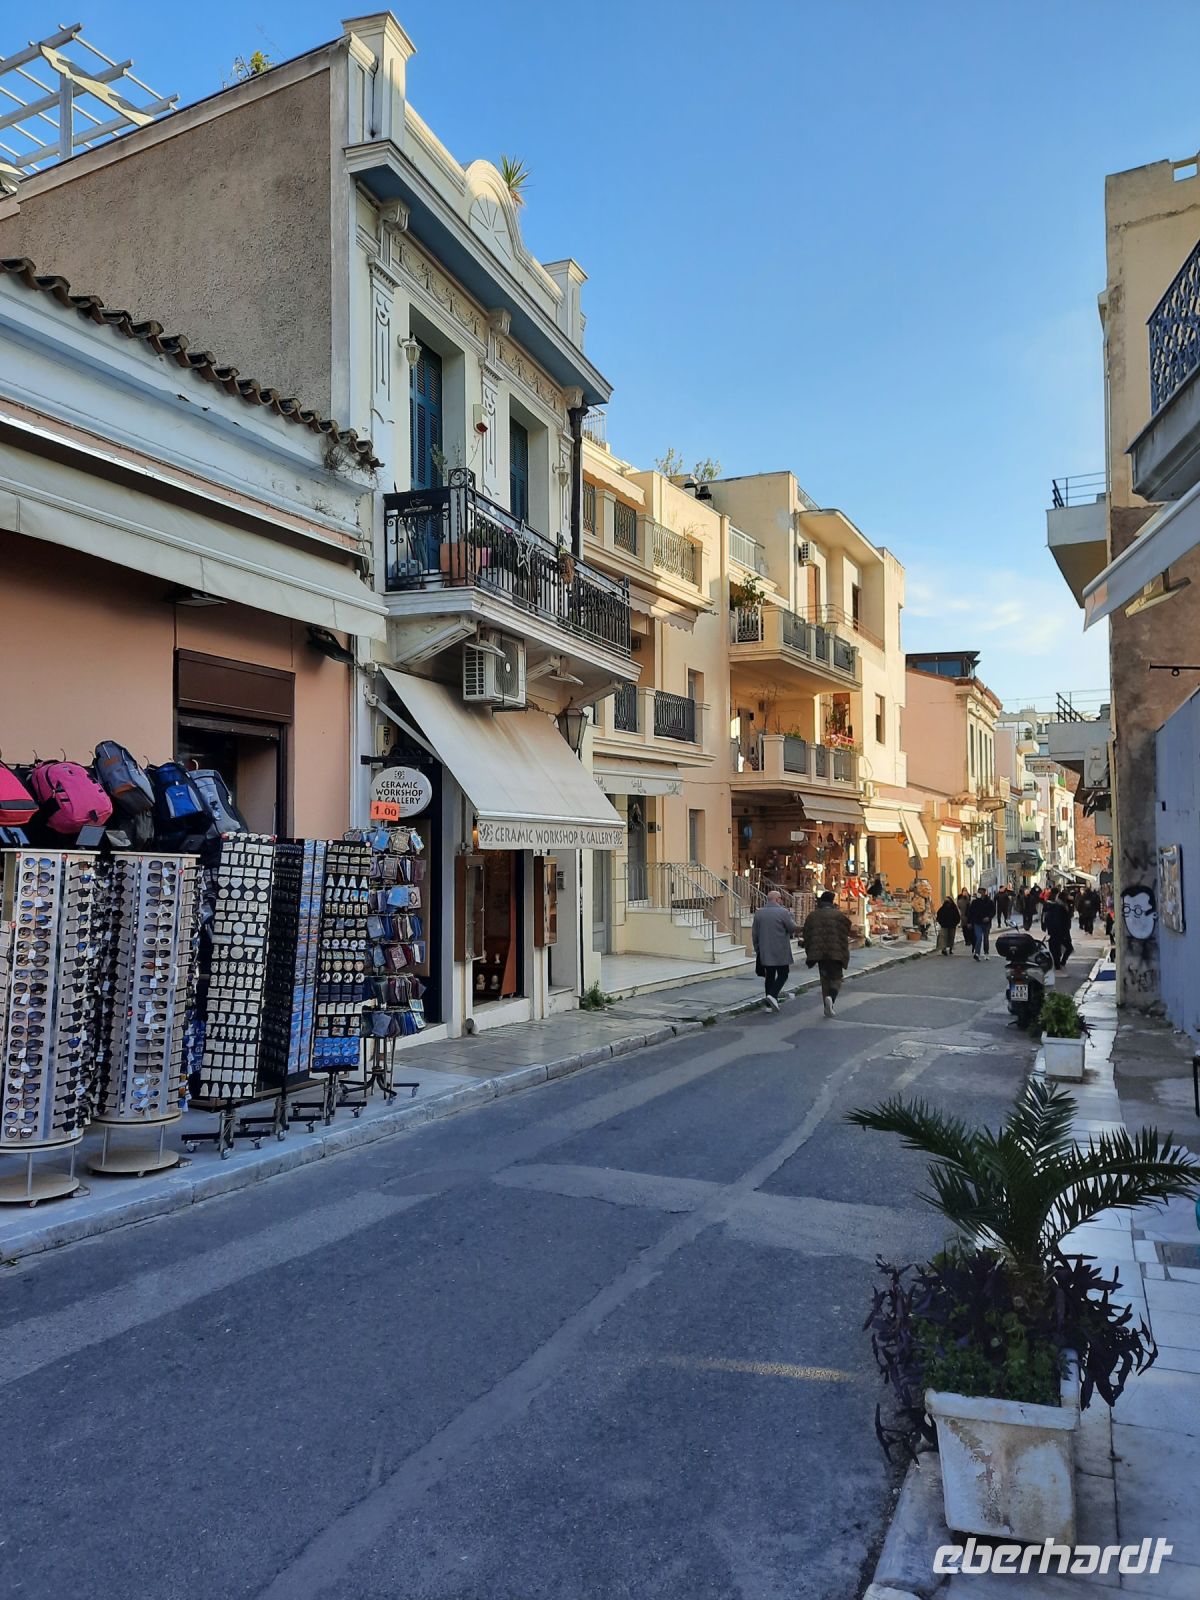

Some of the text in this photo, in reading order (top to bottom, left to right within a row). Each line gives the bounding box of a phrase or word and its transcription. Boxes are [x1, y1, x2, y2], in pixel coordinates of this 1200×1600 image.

[381, 780, 418, 789] CERAMIC
[375, 788, 423, 797] WORKSHOP
[385, 796, 421, 805] GALLERY
[373, 805, 397, 817] 1.00
[495, 826, 613, 845] CERAMIC WORKSHOP & GALLERY
